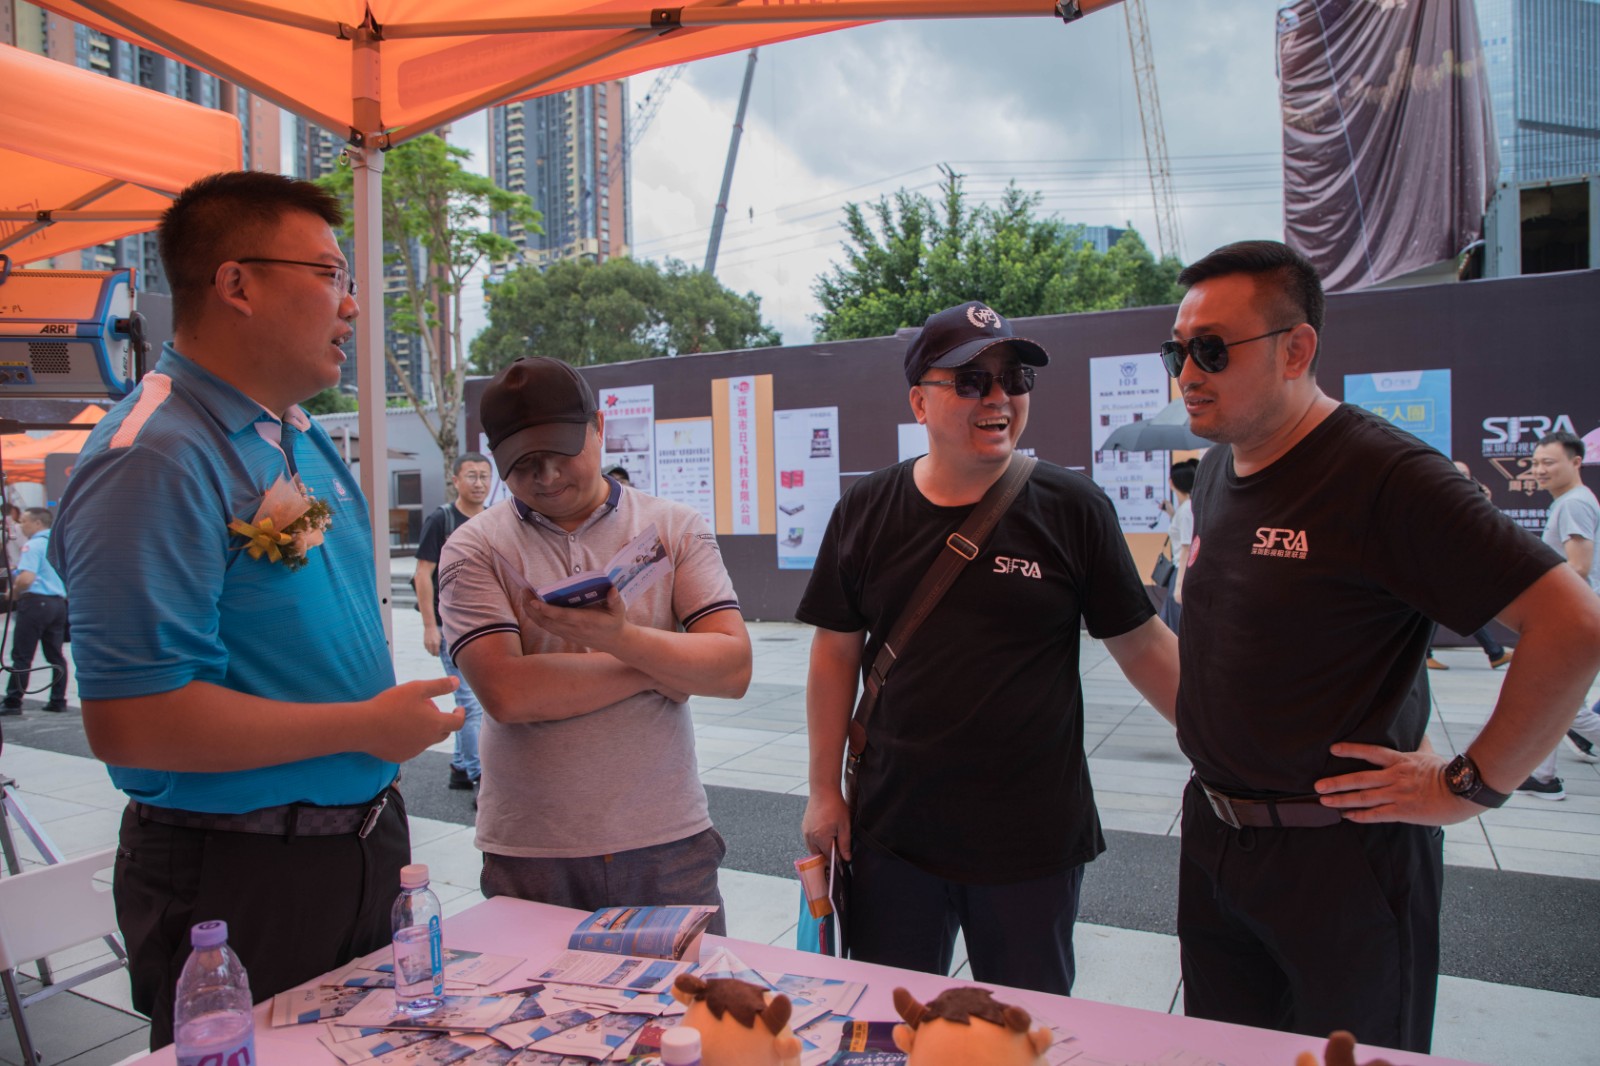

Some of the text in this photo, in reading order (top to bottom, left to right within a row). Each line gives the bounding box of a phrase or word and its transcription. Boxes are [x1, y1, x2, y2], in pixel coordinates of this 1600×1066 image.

[40, 324, 69, 334] ARRI
[1252, 526, 1309, 552] SFRA
[1250, 547, 1307, 560] 深圳影视租赁联盟
[992, 555, 1042, 579] SFRA
